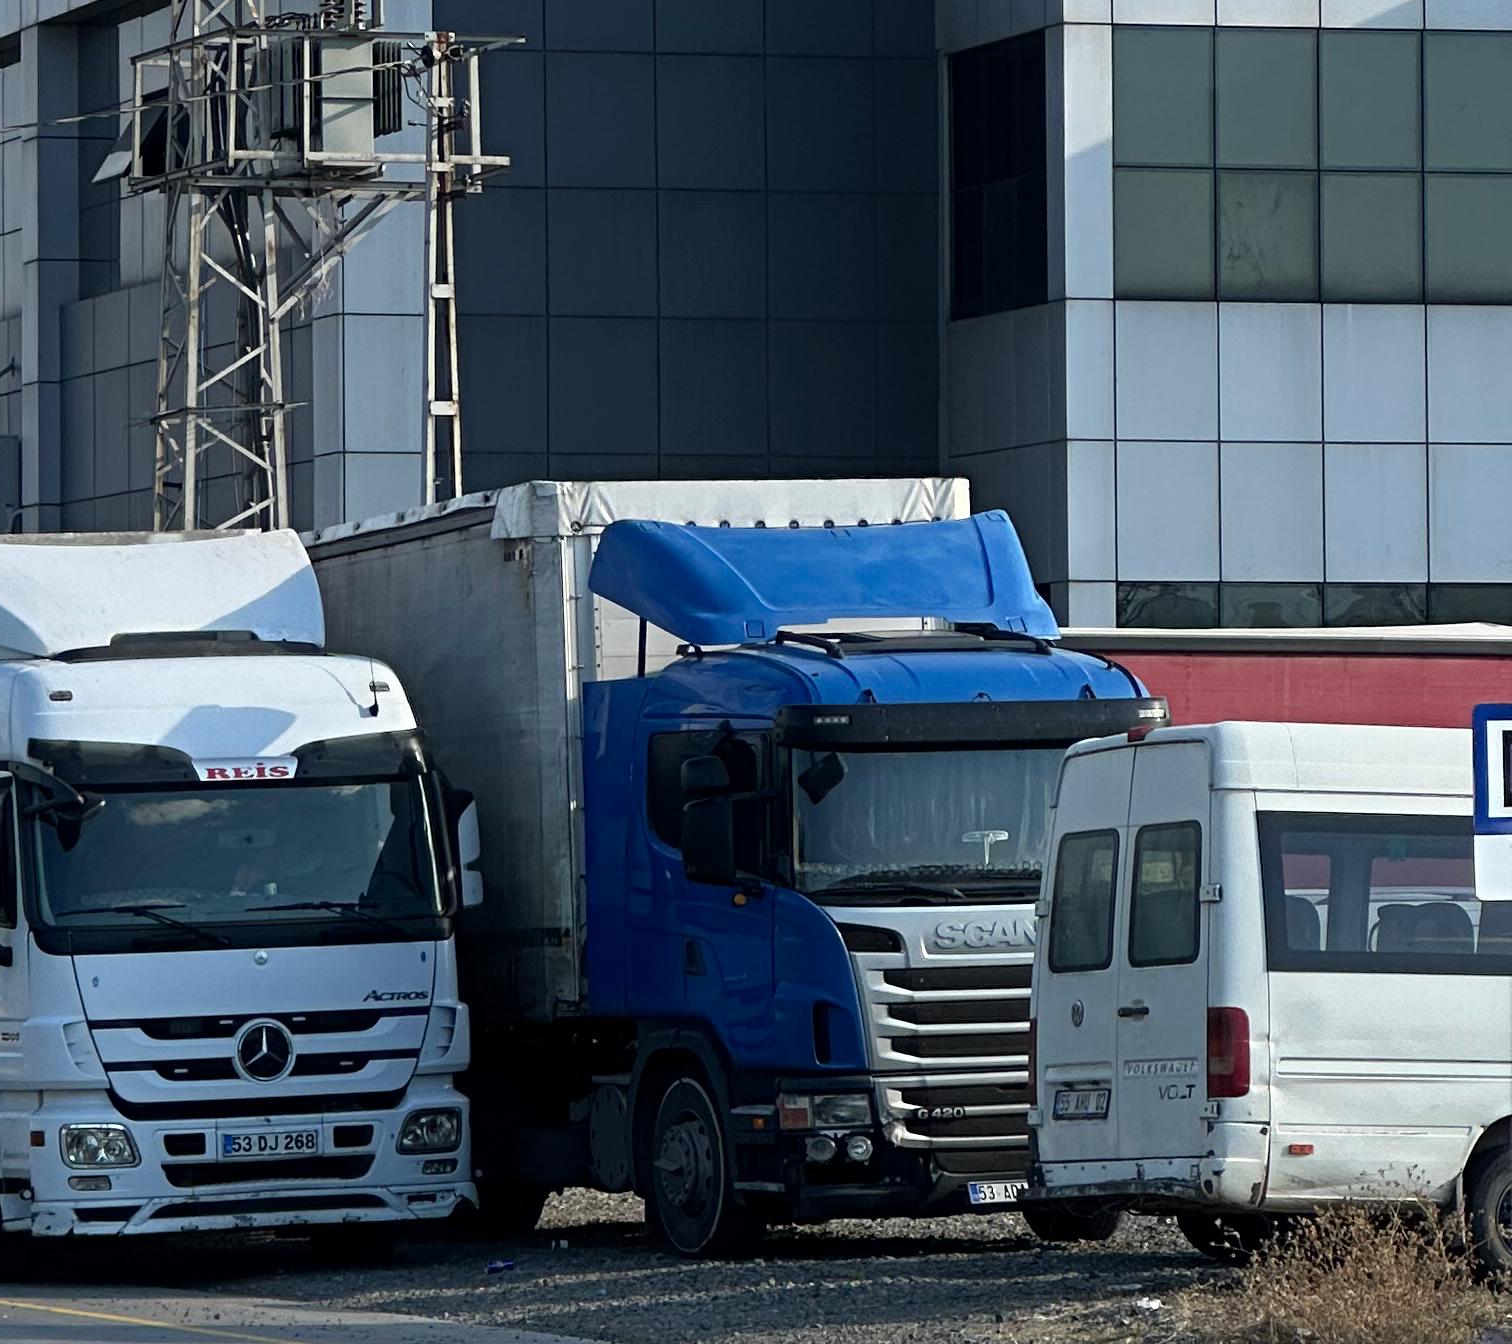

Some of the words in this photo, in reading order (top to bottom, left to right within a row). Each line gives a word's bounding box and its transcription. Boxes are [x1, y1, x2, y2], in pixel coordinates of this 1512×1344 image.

[205, 762, 290, 779] REİS
[917, 1108, 928, 1119] G
[931, 1106, 965, 1118] 420
[232, 1136, 252, 1152] 53
[258, 1135, 279, 1152] DJ
[284, 1133, 315, 1150] 268
[978, 1185, 995, 1201] 53
[1004, 1183, 1025, 1200] AD
